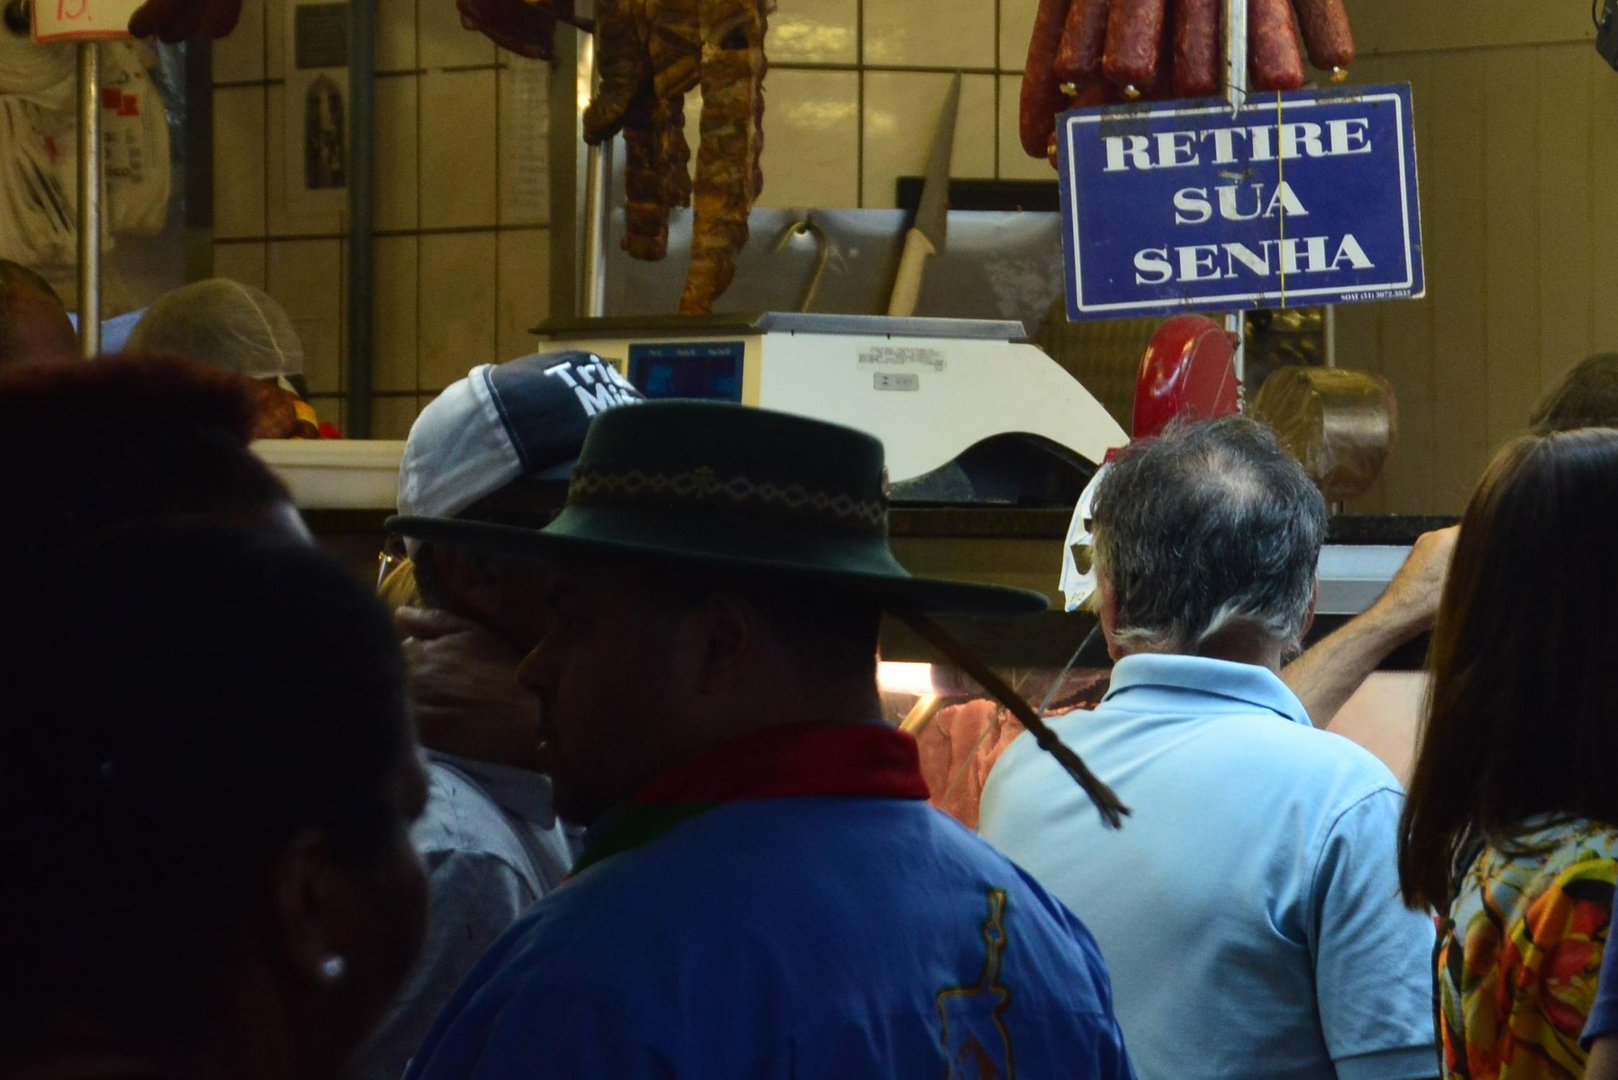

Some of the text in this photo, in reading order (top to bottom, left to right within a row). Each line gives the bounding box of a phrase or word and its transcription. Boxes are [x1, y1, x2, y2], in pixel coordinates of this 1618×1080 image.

[1102, 117, 1373, 173] RETIRE
[1172, 180, 1310, 226] SUA
[1133, 233, 1376, 286] SENHA
